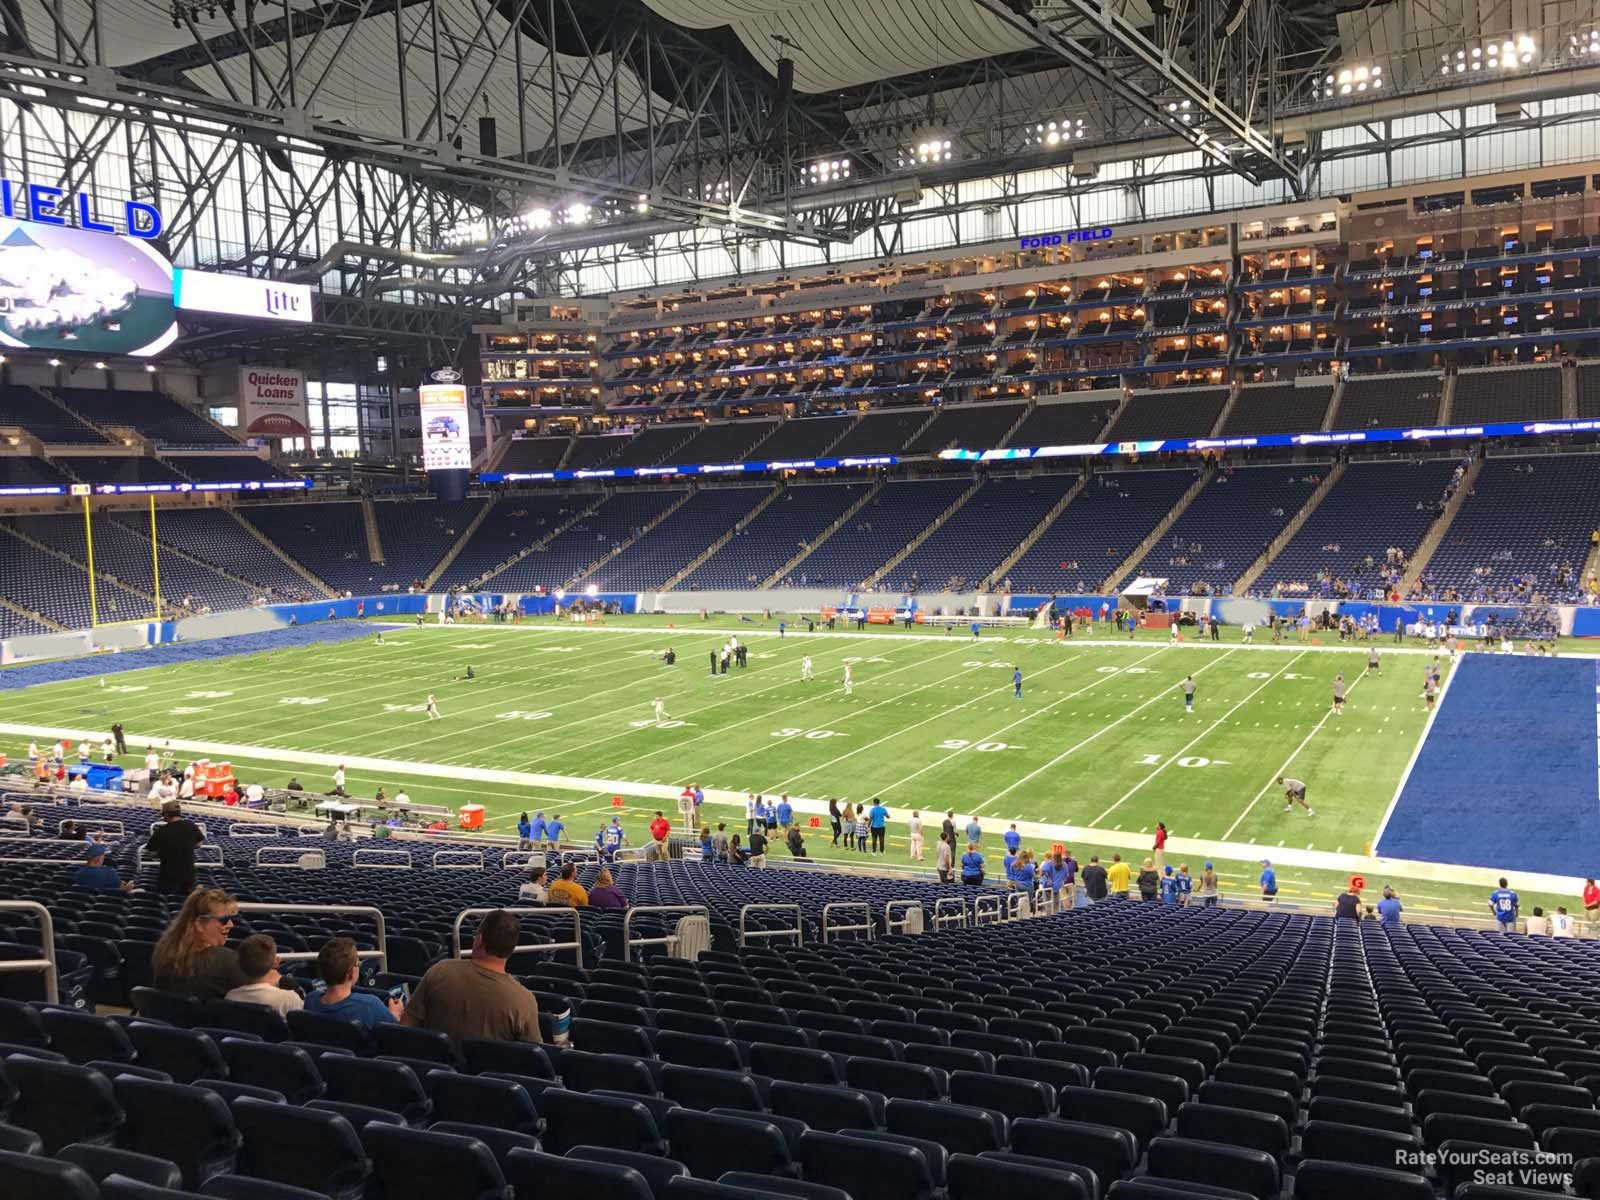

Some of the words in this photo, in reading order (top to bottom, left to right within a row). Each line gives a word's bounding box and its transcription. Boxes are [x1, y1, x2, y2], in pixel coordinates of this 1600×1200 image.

[1020, 234, 1062, 249] FORD
[1067, 227, 1112, 243] FIELD
[266, 288, 299, 315] Lite
[248, 372, 298, 387] Quicken
[257, 386, 295, 399] Loans
[934, 739, 1008, 752] 20
[1134, 753, 1211, 768] 10
[1351, 876, 1364, 889] G
